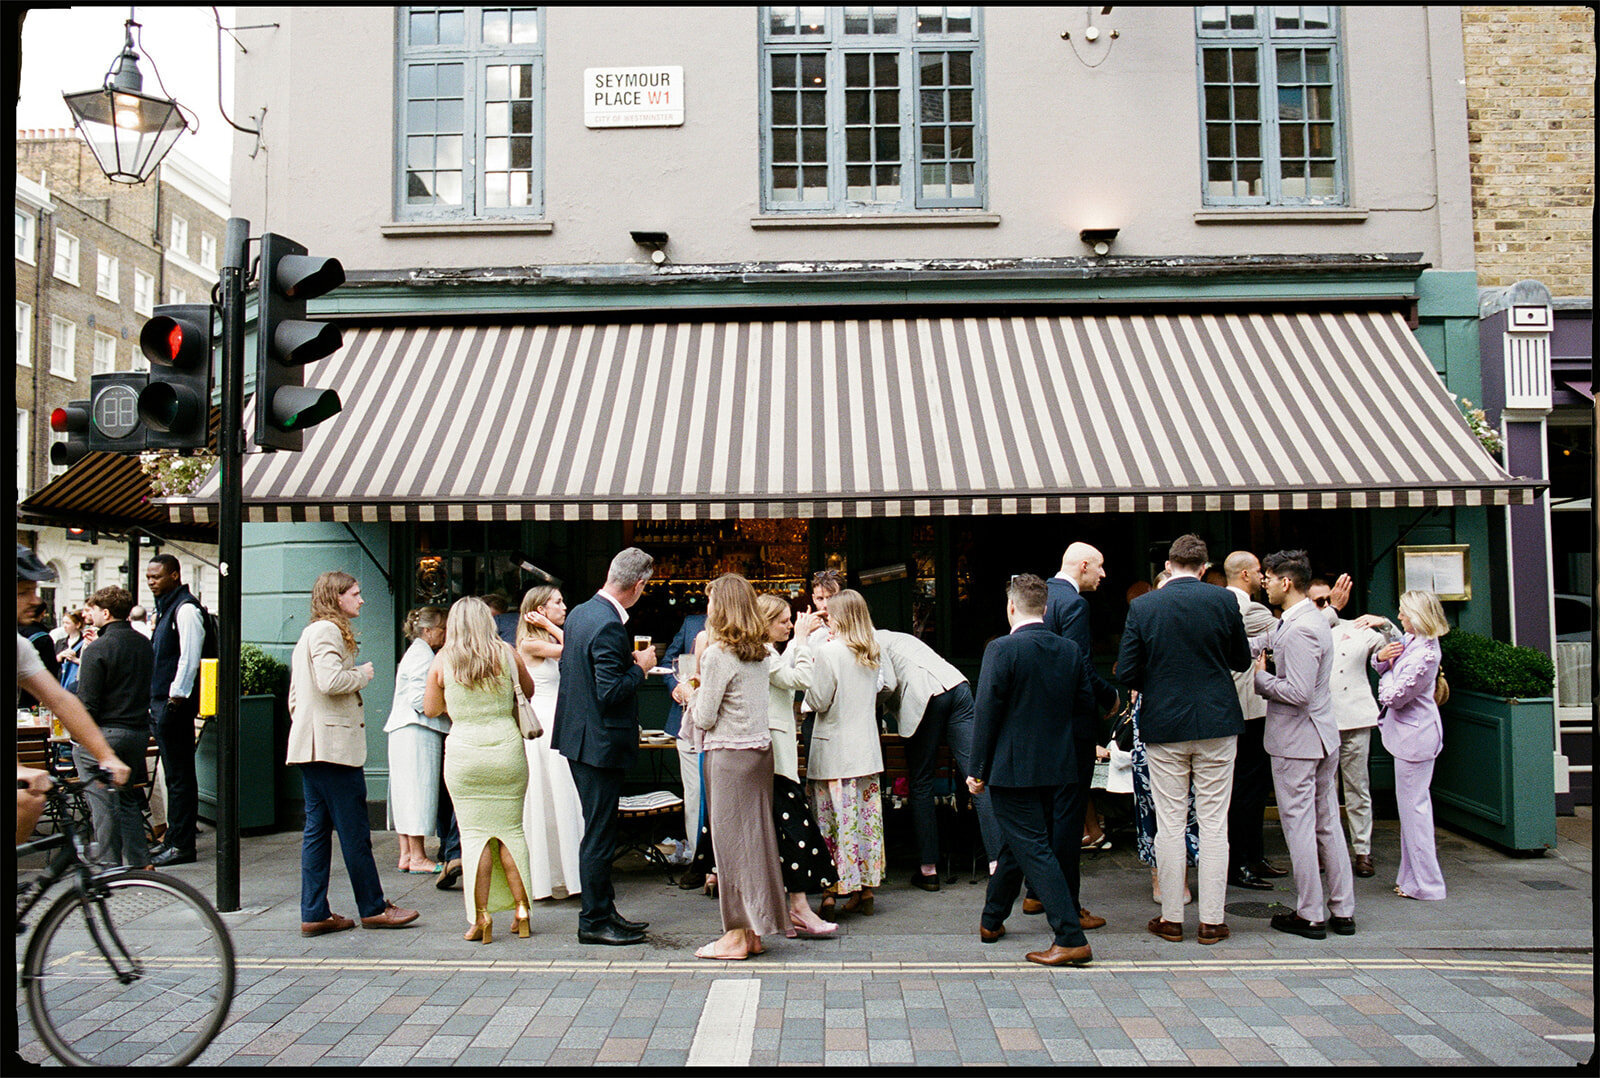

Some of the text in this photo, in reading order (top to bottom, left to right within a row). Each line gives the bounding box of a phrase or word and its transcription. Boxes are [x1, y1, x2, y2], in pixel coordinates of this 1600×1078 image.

[595, 73, 670, 88] SEYMOUR
[594, 91, 669, 106] PLACE W1
[594, 115, 610, 123] CITY
[624, 114, 673, 122] WESTMINSTER
